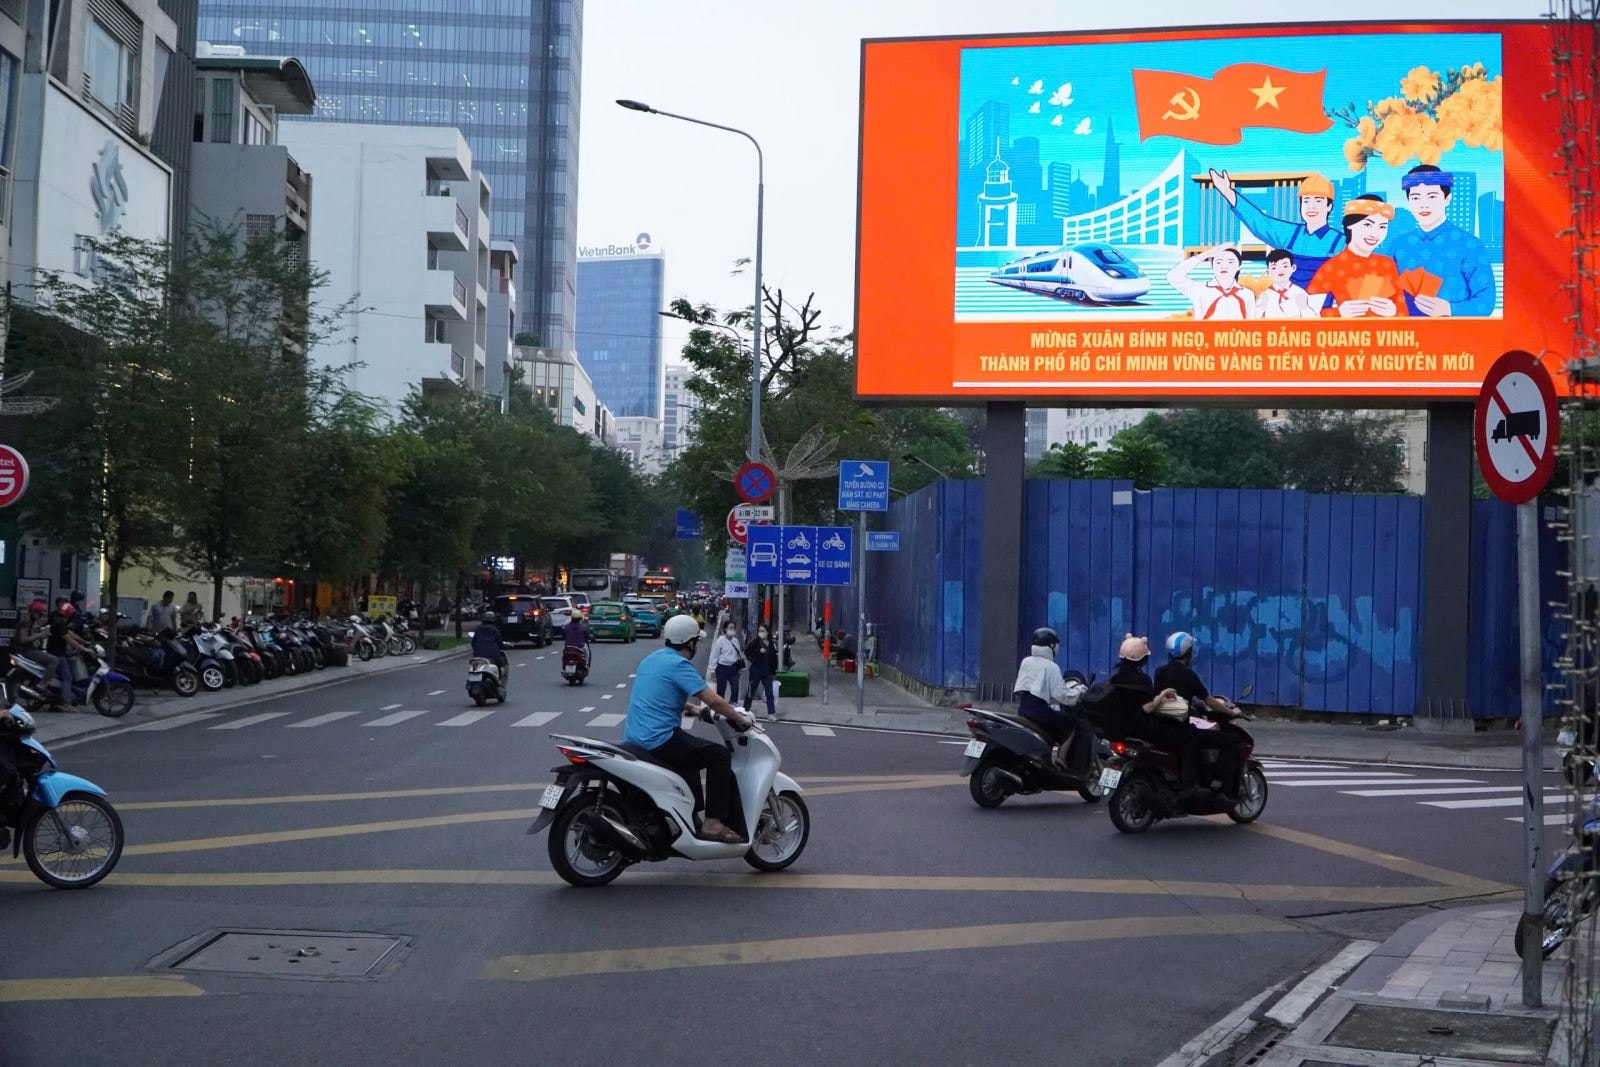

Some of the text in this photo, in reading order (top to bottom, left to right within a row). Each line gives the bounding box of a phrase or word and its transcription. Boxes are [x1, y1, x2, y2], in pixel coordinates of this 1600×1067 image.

[578, 244, 636, 256] VietinBank
[1031, 327, 1419, 350] MỪNG XUÂN BÍNH NGỌ, MỪNG ĐẢNG QUANG VINH,
[980, 350, 1474, 371] THÀNH PHỐ HỒ CHÍ MINH VỮNG VÀNG TIẾN VÀO KỶ NGUYÊN MỚI
[860, 500, 880, 508] CAMERA
[817, 560, 826, 568] XE
[834, 559, 850, 569] BÁNH
